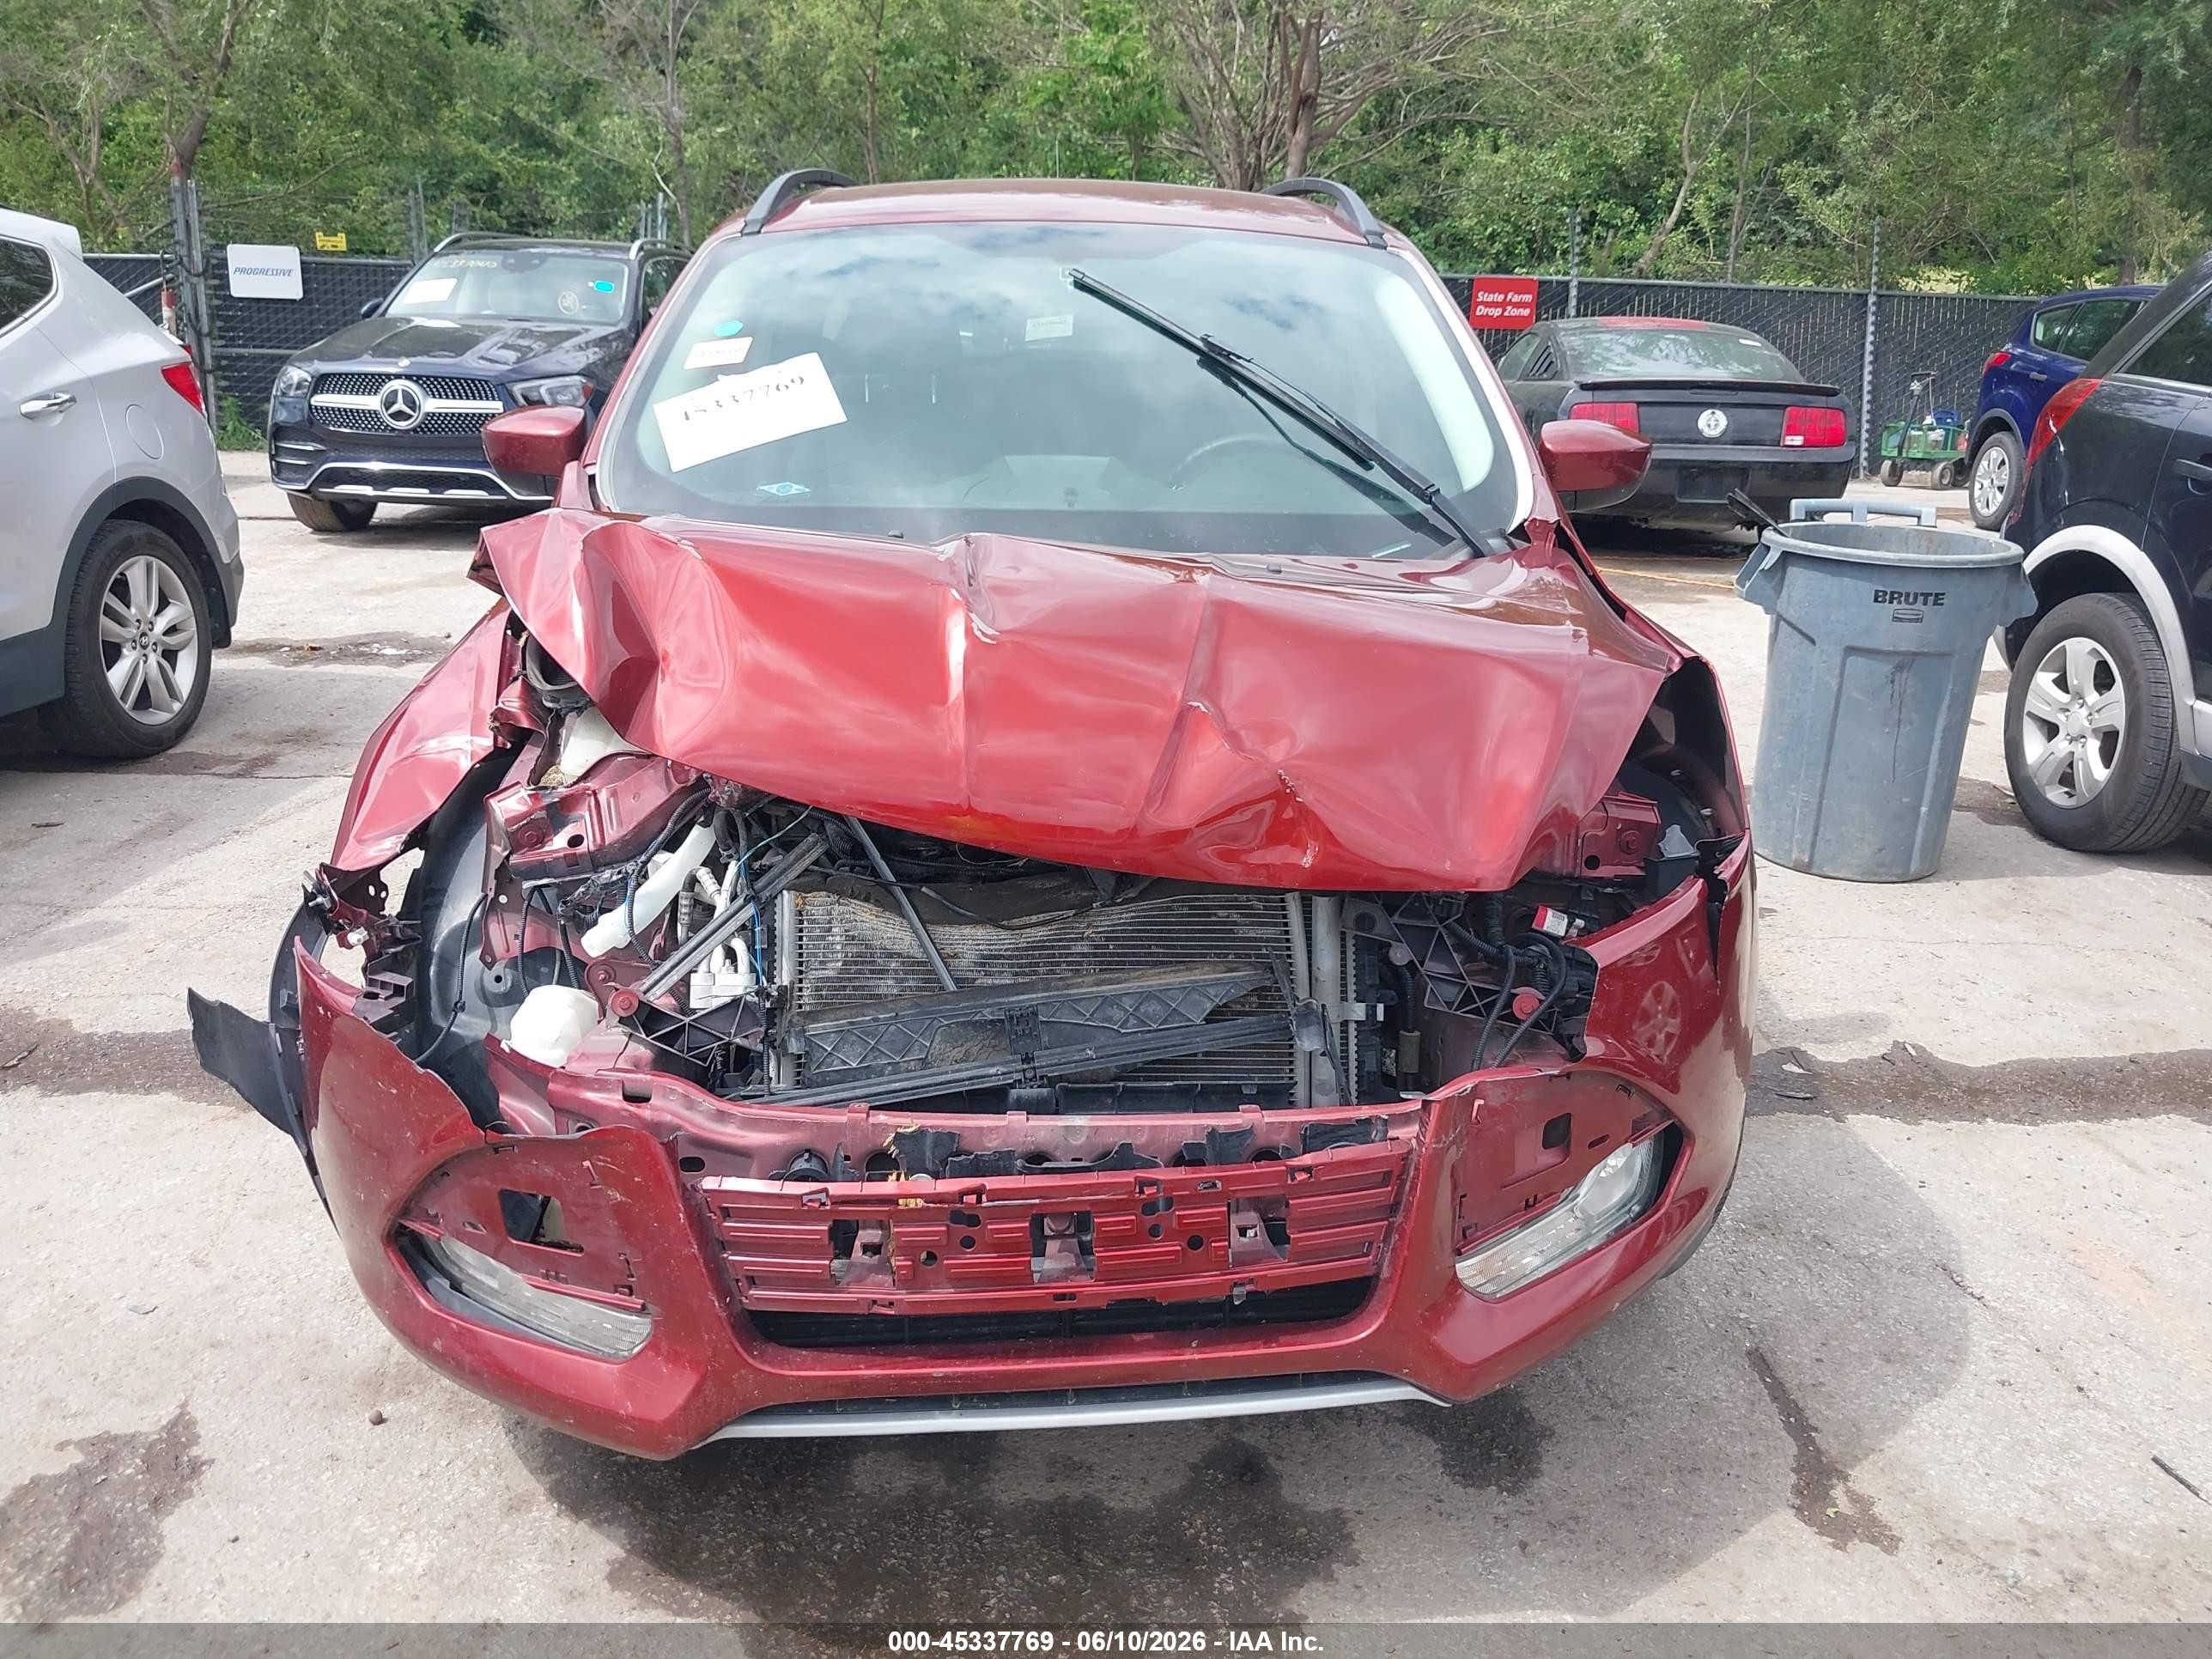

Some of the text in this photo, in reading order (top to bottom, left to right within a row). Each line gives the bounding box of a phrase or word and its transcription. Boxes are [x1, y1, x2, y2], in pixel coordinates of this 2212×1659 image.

[233, 266, 295, 277] PROGRESSIVE
[1476, 291, 1533, 302] State Farm
[1475, 305, 1530, 318] Drop Zone
[1873, 589, 1946, 606] BRUTE
